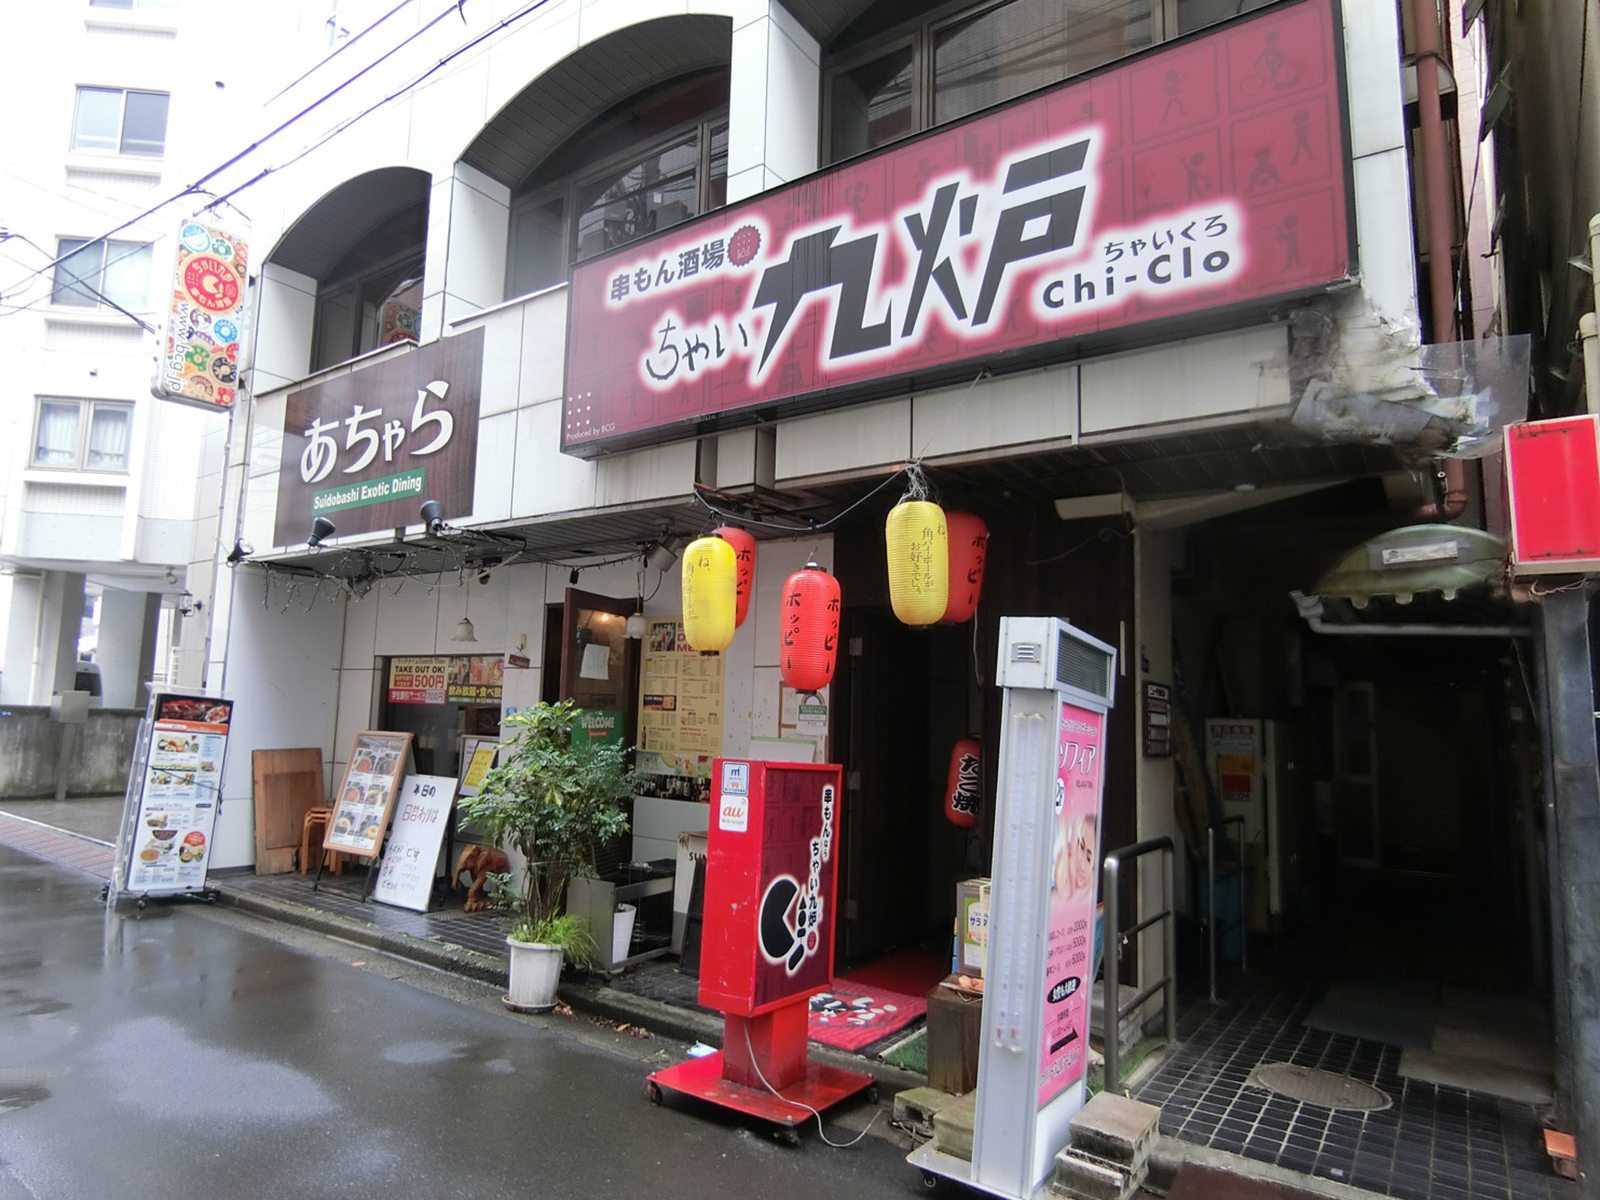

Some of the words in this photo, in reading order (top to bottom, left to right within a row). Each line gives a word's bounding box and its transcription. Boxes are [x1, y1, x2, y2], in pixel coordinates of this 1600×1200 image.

[1103, 213, 1230, 263] ちゃいくろ
[610, 238, 725, 302] 串もん酒場
[1042, 247, 1230, 310] Chi-Clo
[166, 302, 191, 392] www.bcg.jp
[300, 380, 454, 484] あちゃら
[566, 428, 592, 441] Produced
[592, 427, 601, 436] by
[601, 422, 616, 433] BCG
[313, 489, 360, 510] Suidobashi
[360, 482, 390, 500] Exotic
[391, 476, 422, 493] Dining
[910, 541, 922, 594] お好きでしょ
[921, 527, 934, 588] 角ハイボールが
[784, 590, 802, 669] ホッピー
[395, 665, 413, 674] TAKE
[414, 665, 430, 674] OUT
[431, 665, 446, 674] OK!
[414, 674, 445, 689] 500円
[581, 716, 615, 729] WELCOME
[413, 783, 437, 798] 本日の
[723, 806, 745, 818] au
